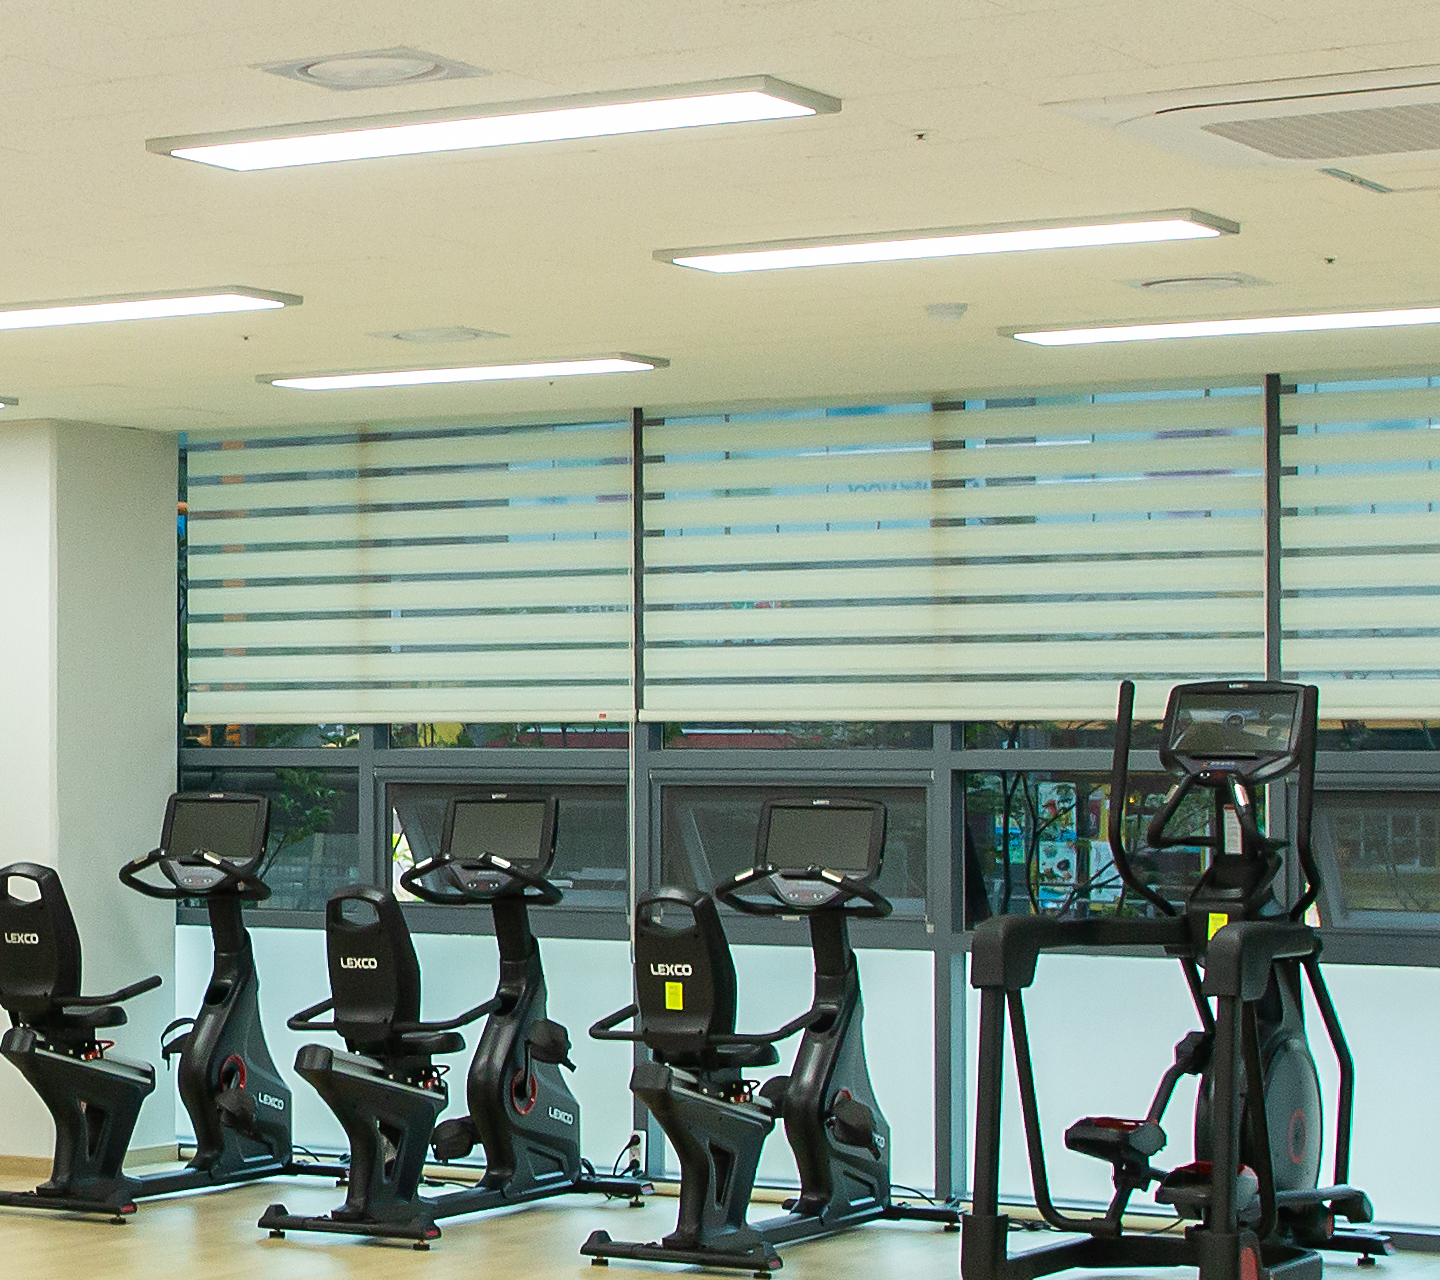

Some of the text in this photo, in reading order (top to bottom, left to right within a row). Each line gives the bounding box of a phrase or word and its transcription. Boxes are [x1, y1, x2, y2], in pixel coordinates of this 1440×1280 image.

[4, 932, 39, 944] LEXCO
[340, 957, 378, 969] LEXCO
[650, 963, 693, 976] LEXCO
